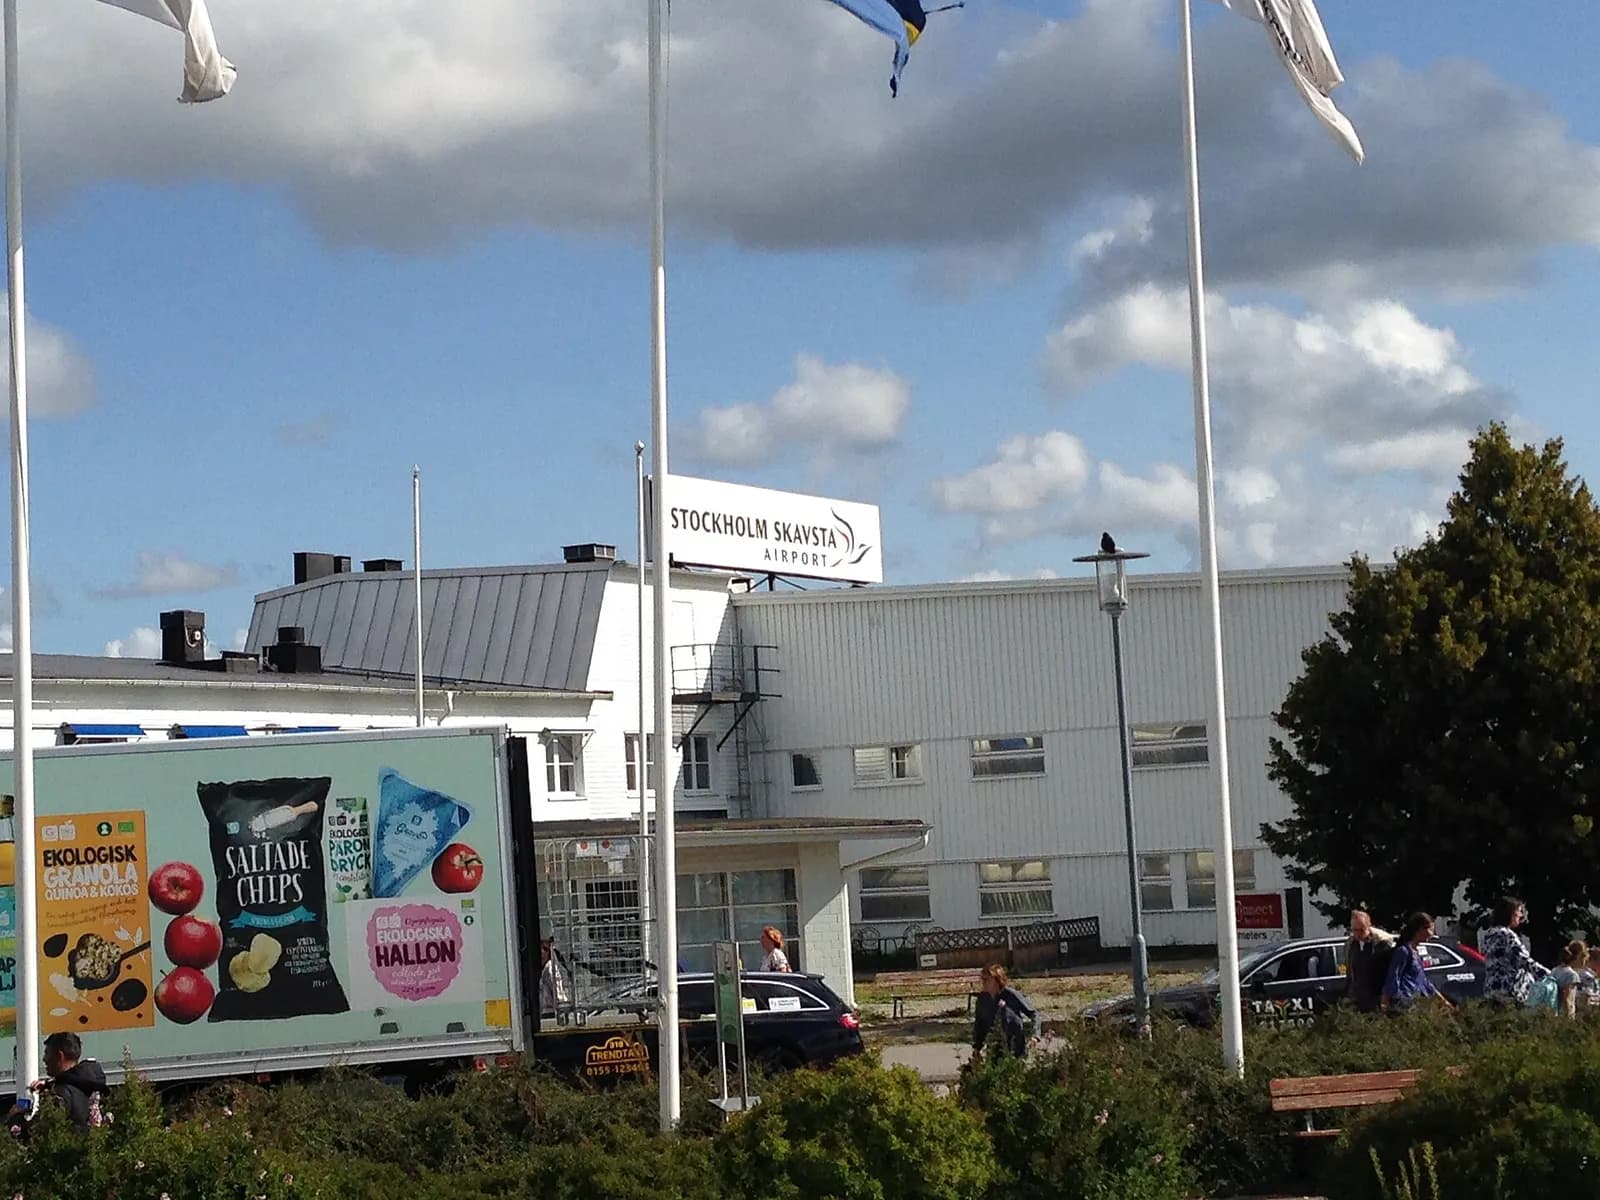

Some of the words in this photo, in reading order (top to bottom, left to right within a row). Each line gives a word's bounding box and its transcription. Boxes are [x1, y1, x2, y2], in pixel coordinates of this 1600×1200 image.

[671, 507, 768, 539] STOCKHOLM
[774, 521, 837, 549] SKAVSTA
[764, 548, 828, 568] AIRPORT
[43, 844, 138, 867] EKOLOGISK
[225, 840, 311, 879] SALTADE
[331, 854, 372, 873] DRYCK
[44, 863, 138, 889] GRANOLA
[100, 883, 139, 897] KOKOS
[237, 873, 304, 907] CHIPS
[376, 926, 453, 944] EKOLOGISKA
[375, 940, 456, 967] HALLON
